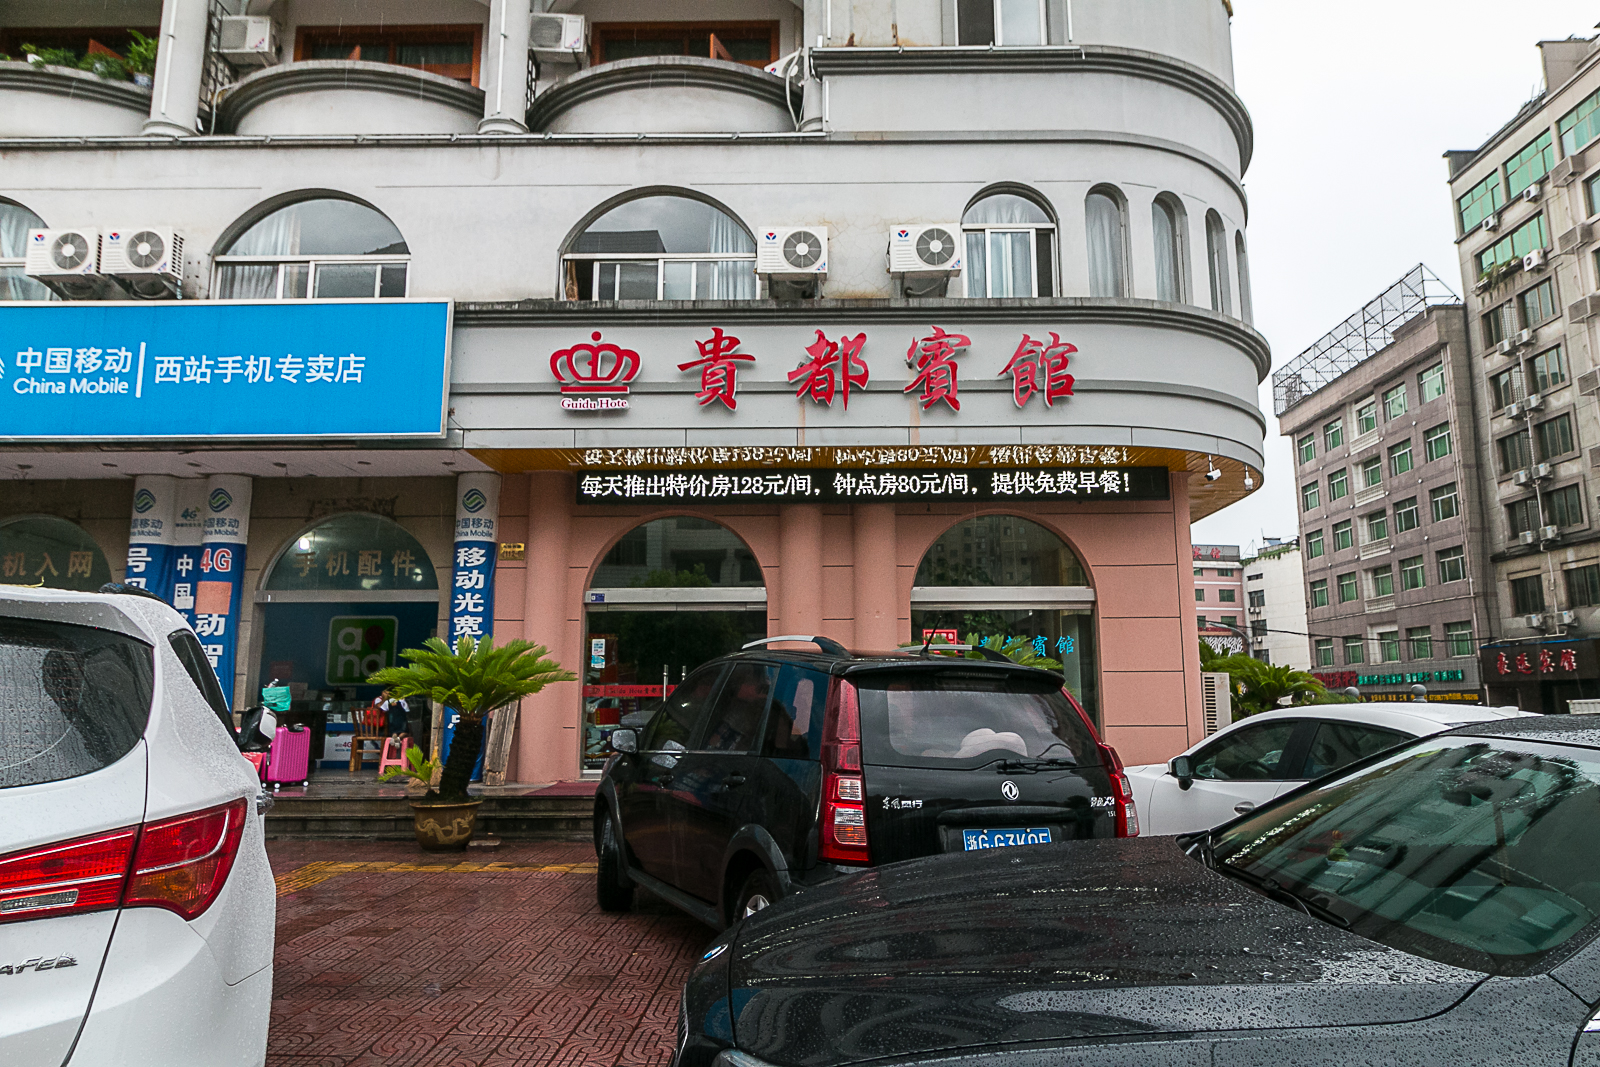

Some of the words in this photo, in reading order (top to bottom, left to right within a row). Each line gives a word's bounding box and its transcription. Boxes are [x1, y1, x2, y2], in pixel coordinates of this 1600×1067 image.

[15, 346, 132, 374] 中国移动
[154, 353, 366, 384] 西站手机专卖店
[13, 377, 66, 394] China
[69, 376, 130, 394] Mobile
[561, 399, 596, 409] Guidu
[199, 548, 233, 573] 4G
[292, 550, 417, 578] 手机配件
